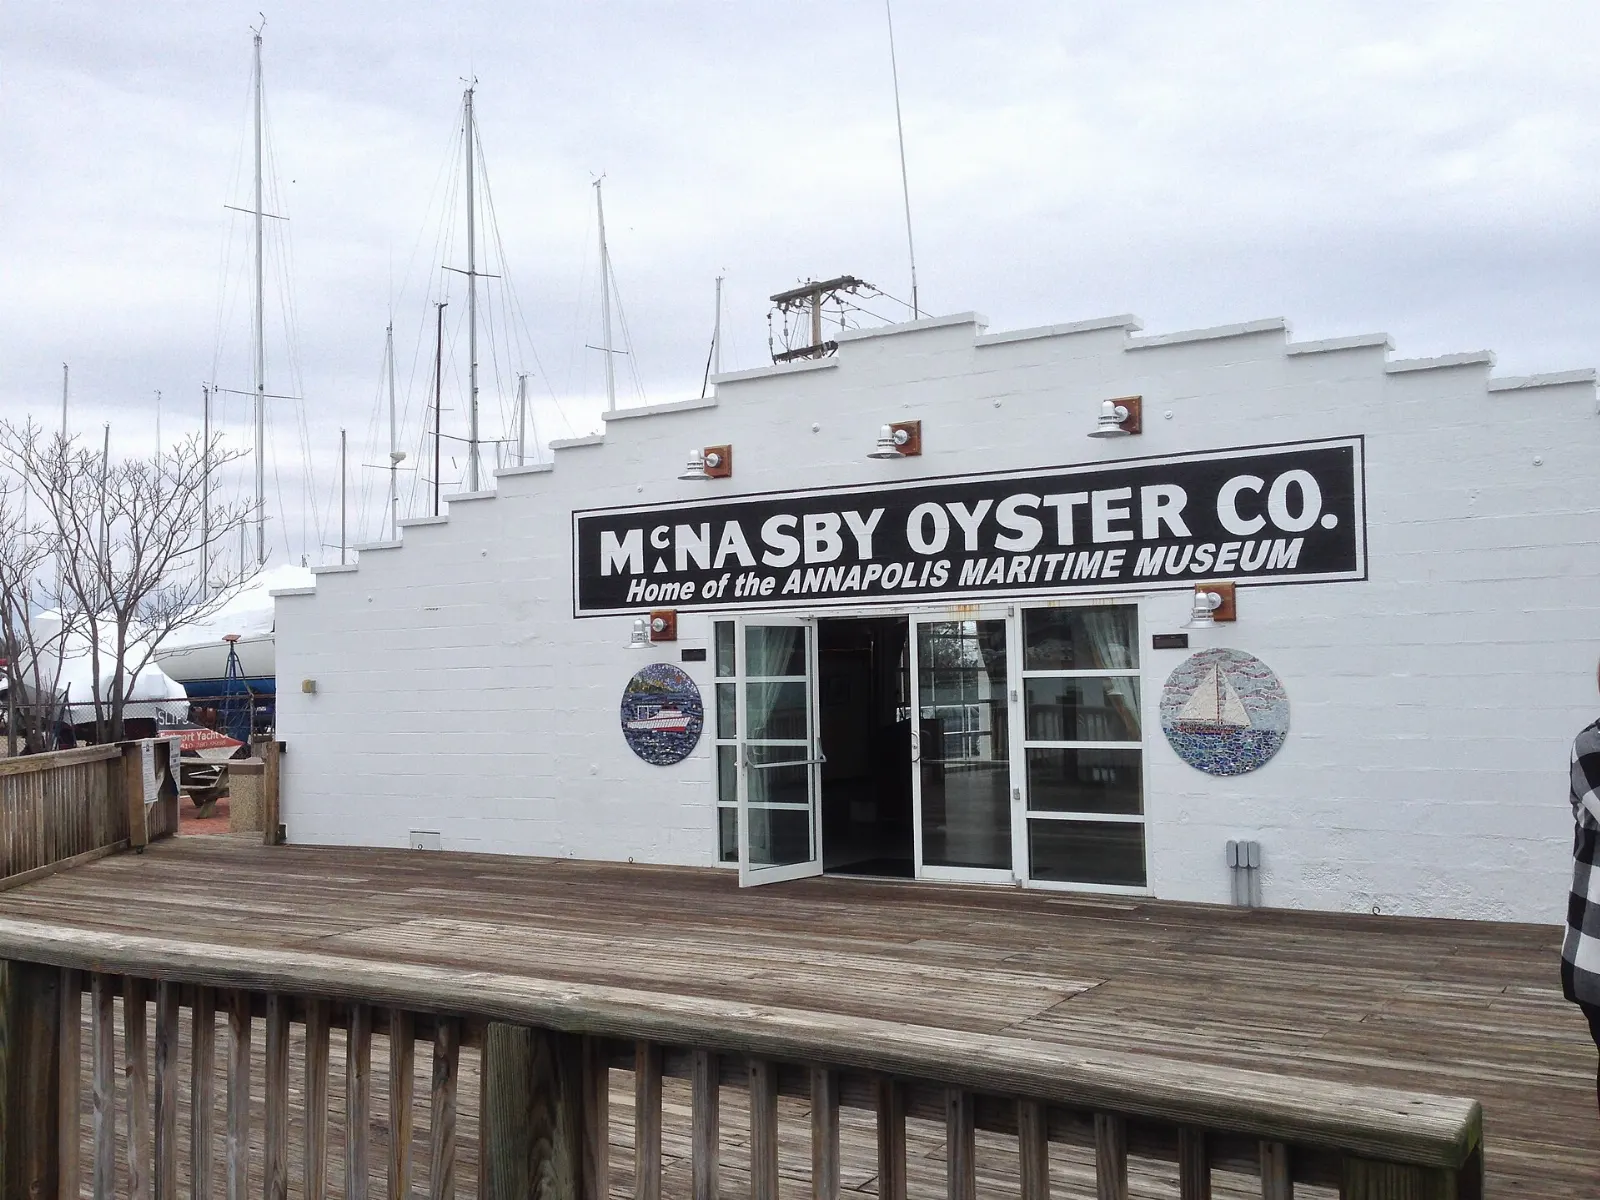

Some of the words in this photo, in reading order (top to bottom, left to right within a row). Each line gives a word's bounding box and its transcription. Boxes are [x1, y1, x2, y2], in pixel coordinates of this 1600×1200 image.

[906, 484, 1193, 555] OYSTER
[1216, 469, 1339, 536] CO.
[625, 577, 696, 603] Home
[701, 572, 730, 600] of
[734, 571, 776, 598] the
[781, 558, 951, 596] ANNAPOLIS
[957, 548, 1127, 588] MARITIME
[1132, 537, 1305, 578] MUSEUM
